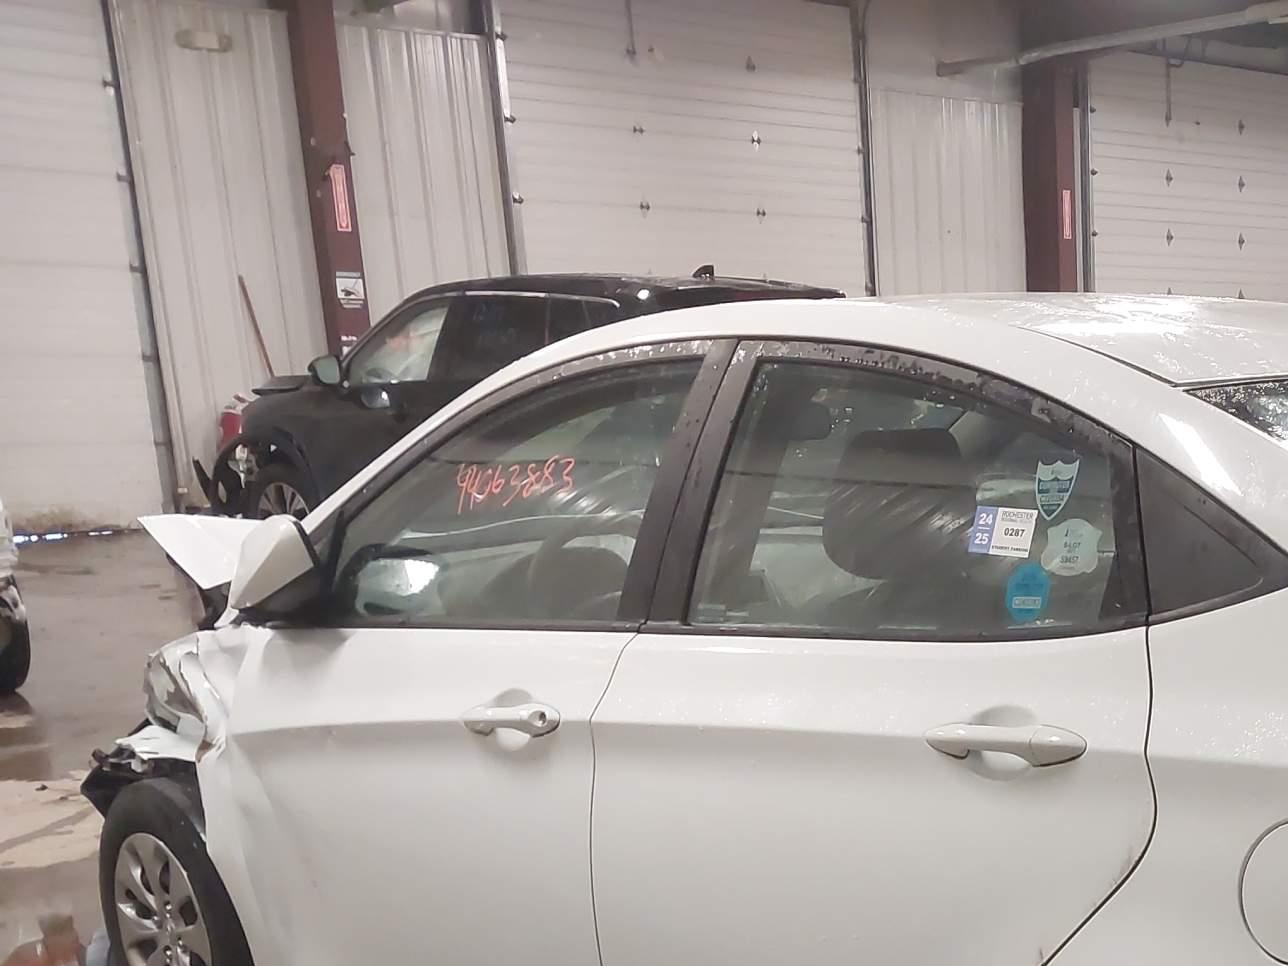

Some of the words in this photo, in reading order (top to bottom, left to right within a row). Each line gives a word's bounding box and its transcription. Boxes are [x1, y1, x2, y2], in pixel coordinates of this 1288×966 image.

[456, 454, 576, 515] 44063883
[978, 512, 993, 525] 24
[974, 532, 990, 545] 25
[1003, 527, 1025, 538] 0287
